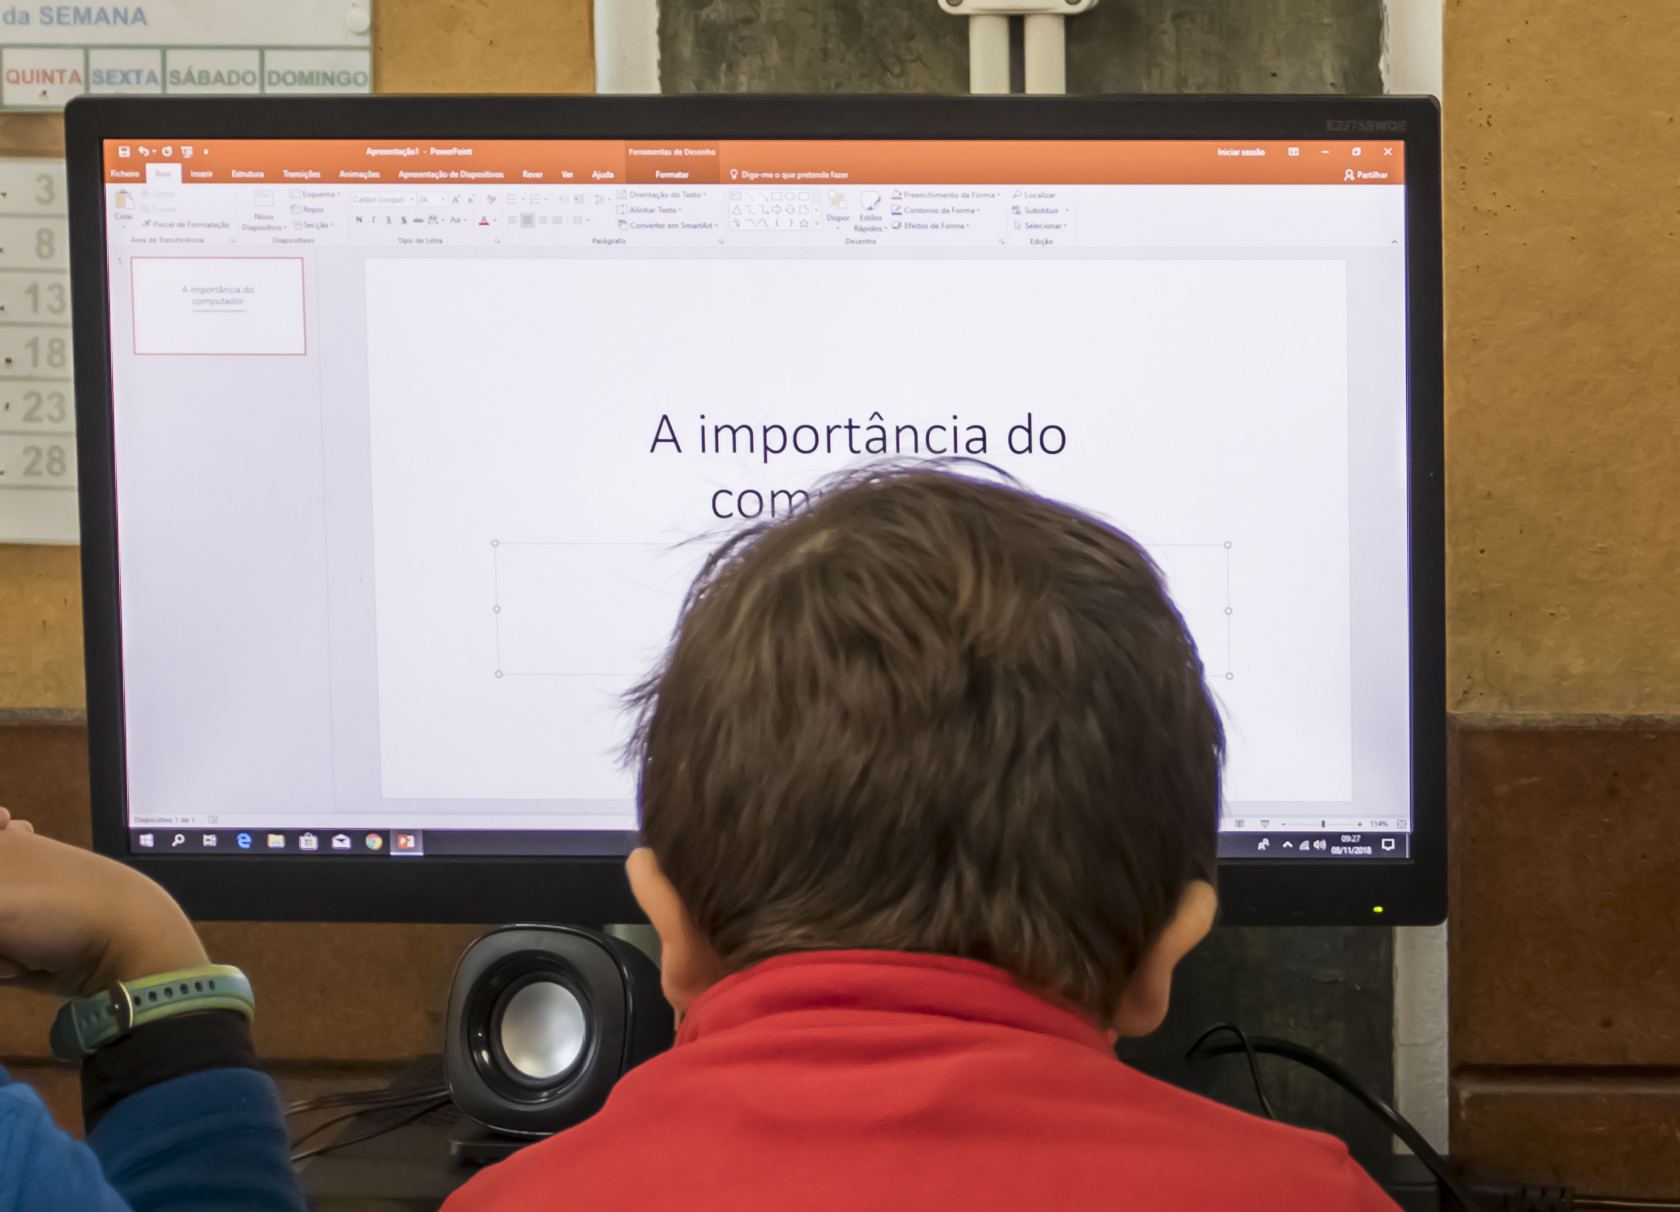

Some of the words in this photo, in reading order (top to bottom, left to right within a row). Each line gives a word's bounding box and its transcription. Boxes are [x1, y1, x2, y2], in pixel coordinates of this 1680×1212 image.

[3, 5, 31, 26] da
[39, 5, 148, 27] SEMANA
[5, 68, 81, 85] QUINTA
[92, 69, 158, 85] SEXTA
[169, 65, 257, 87] SÁBADO
[267, 69, 368, 88] DOMINGO
[430, 148, 473, 156] PowerPoint
[629, 148, 672, 156] Ferramentas
[673, 148, 682, 156] de
[684, 148, 716, 156] Desenho
[1217, 148, 1240, 156] Iniciar
[1241, 148, 1266, 156] sessão
[110, 170, 140, 178] Ficheiro
[190, 170, 213, 178] Inserir
[231, 170, 264, 178] Estrutura
[283, 169, 321, 179] Transições
[339, 170, 380, 179] Animações
[398, 170, 448, 179] Apresentação
[449, 170, 459, 178] de
[460, 170, 504, 179] Diapositivos
[592, 170, 614, 180] Ajuda
[655, 170, 689, 179] Formatar
[741, 171, 773, 180] Diga-me
[781, 172, 795, 180] que
[797, 171, 829, 180] pretende
[830, 171, 849, 179] fazer
[1357, 171, 1388, 179] Partilhar
[35, 173, 55, 205] 3
[35, 228, 55, 260] 8
[181, 286, 188, 294] A
[190, 285, 241, 296] importância
[242, 286, 254, 294] do
[24, 282, 67, 314] 13
[192, 297, 244, 306] computador
[24, 336, 67, 368] 18
[22, 390, 67, 423] 23
[650, 414, 682, 454] A
[700, 411, 989, 464] importância
[1007, 412, 1068, 455] do
[22, 444, 67, 477] 28
